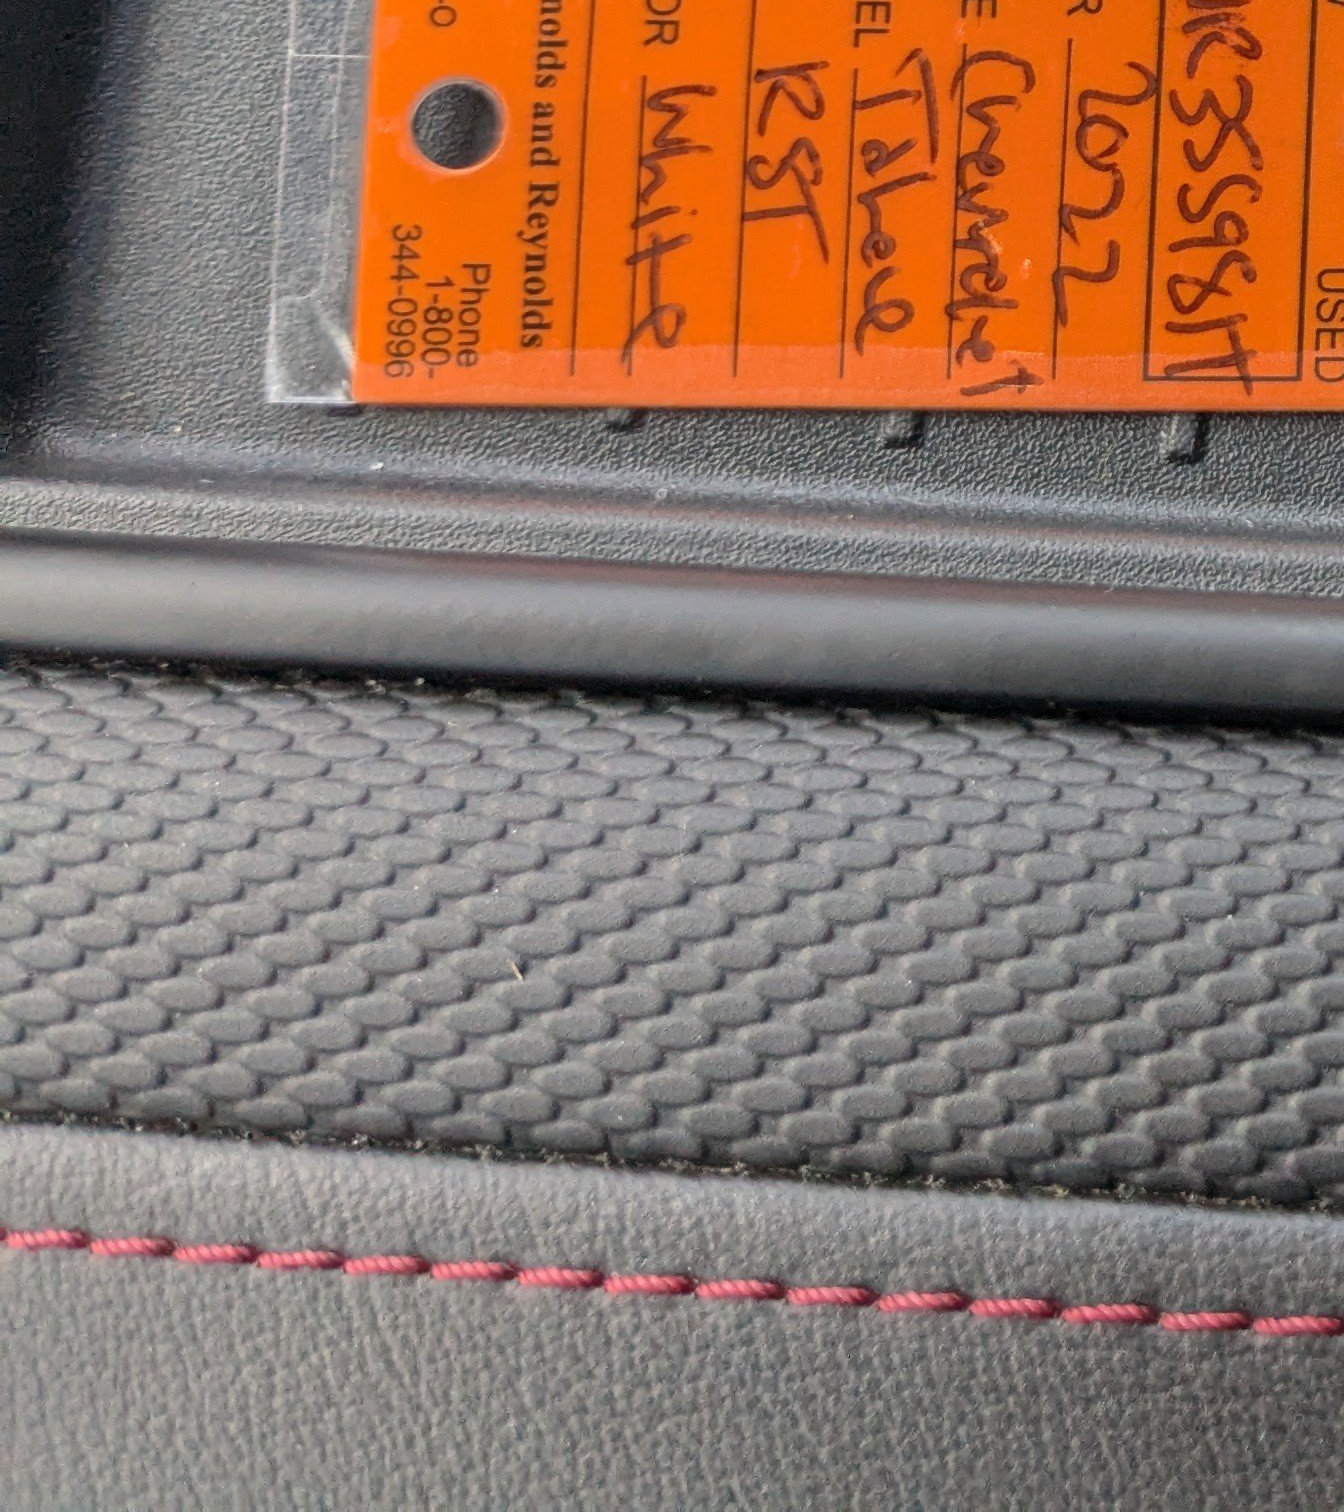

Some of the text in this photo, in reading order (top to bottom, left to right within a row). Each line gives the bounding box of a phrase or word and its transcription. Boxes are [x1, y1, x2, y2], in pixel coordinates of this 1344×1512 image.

[529, 102, 561, 167] and
[743, 60, 830, 264] RST
[1052, 62, 1157, 328] 2022
[384, 224, 422, 378] 344-0996
[516, 182, 560, 349] Reynolds
[622, 84, 717, 364] White
[421, 275, 452, 379] 1-800-
[456, 263, 492, 368] Phone
